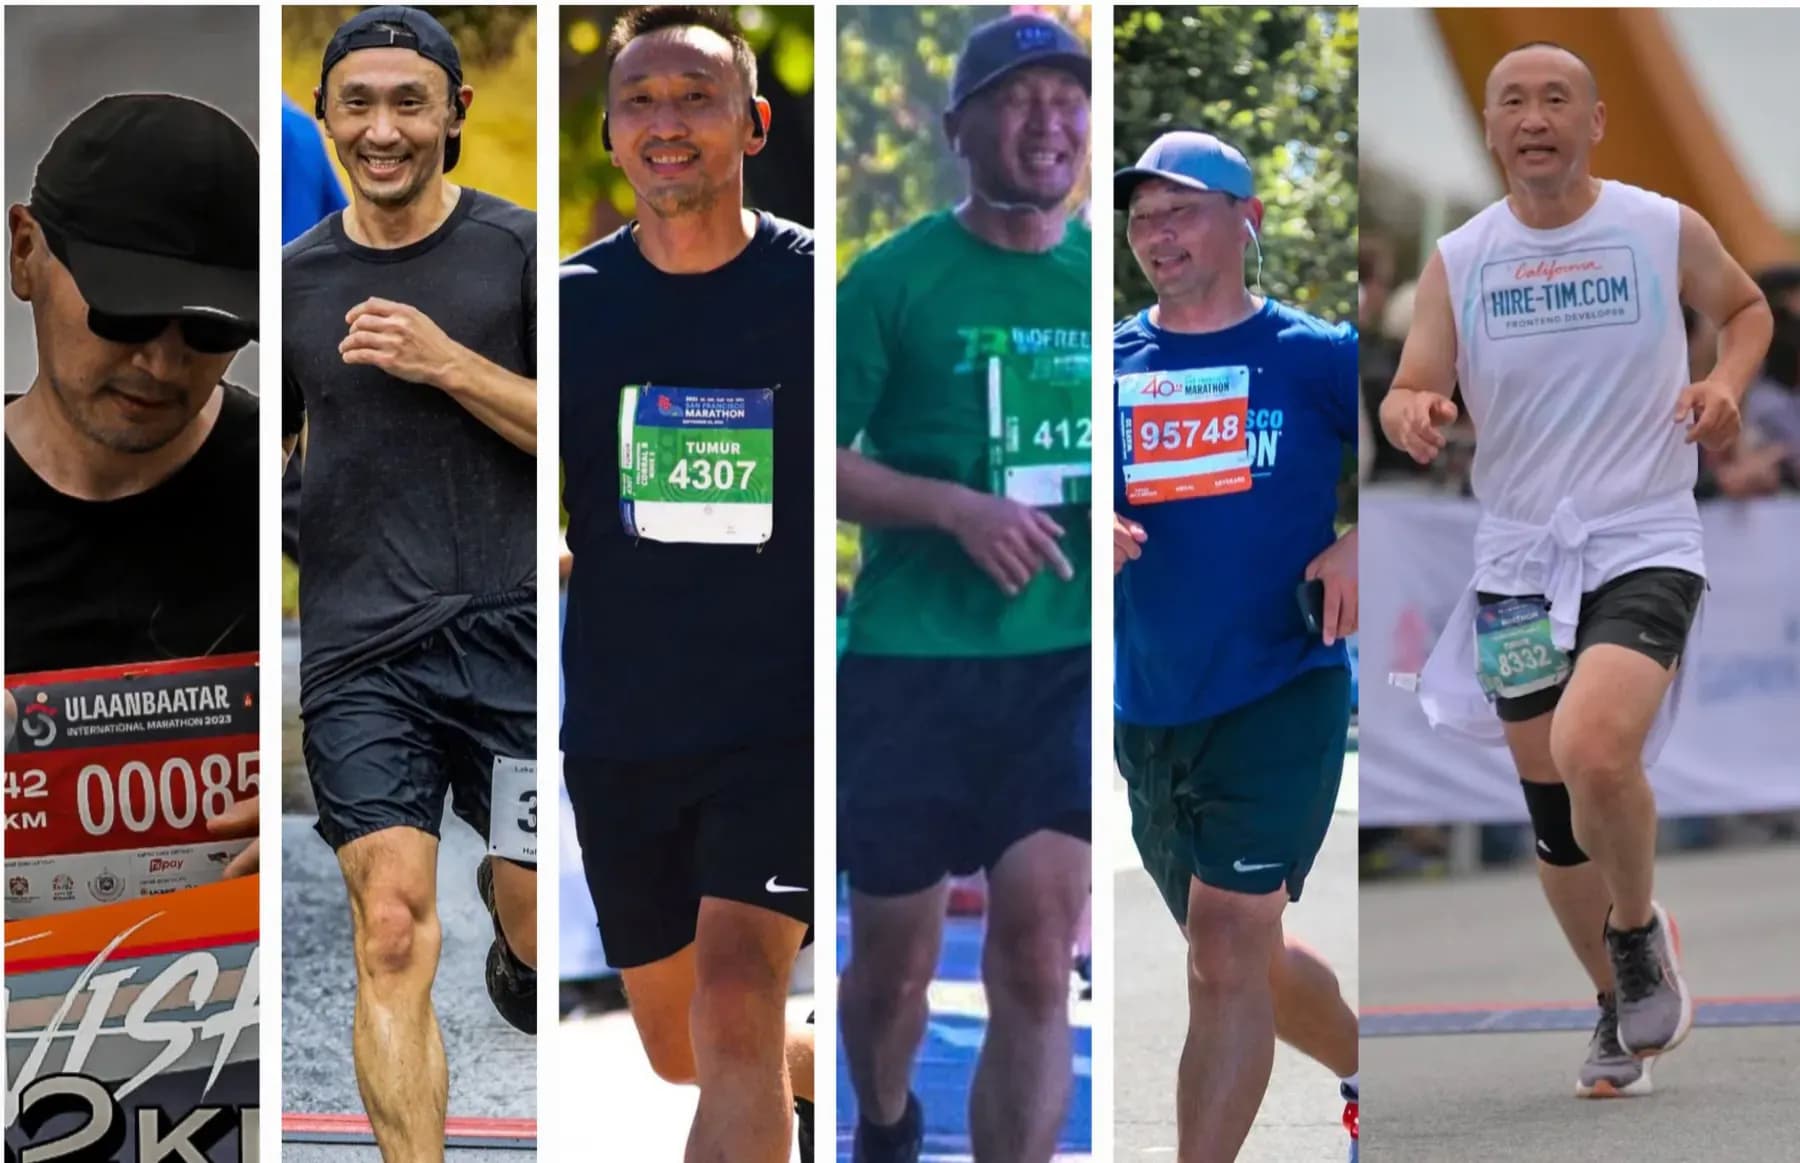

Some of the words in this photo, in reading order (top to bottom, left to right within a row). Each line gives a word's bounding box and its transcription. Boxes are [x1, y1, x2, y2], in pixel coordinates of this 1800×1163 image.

[1514, 259, 1601, 281] California
[1491, 276, 1629, 317] HIRE-TIM.COM
[1506, 316, 1561, 329] FRONTEND
[1564, 307, 1625, 323] DEVELOPER
[1185, 382, 1230, 396] MARATHON
[685, 409, 745, 419] MARATHON
[1033, 417, 1091, 450] 412
[1140, 414, 1239, 451] 95748
[686, 442, 741, 455] TUMUR
[668, 459, 757, 490] 4307
[1499, 645, 1552, 676] 8332
[65, 685, 231, 722] ULAANBAATAR
[67, 722, 145, 737] INTERNATIONAL
[147, 718, 202, 731] MARATHON
[204, 714, 232, 726] 2023
[5, 769, 49, 799] 42
[5, 811, 48, 830] KM
